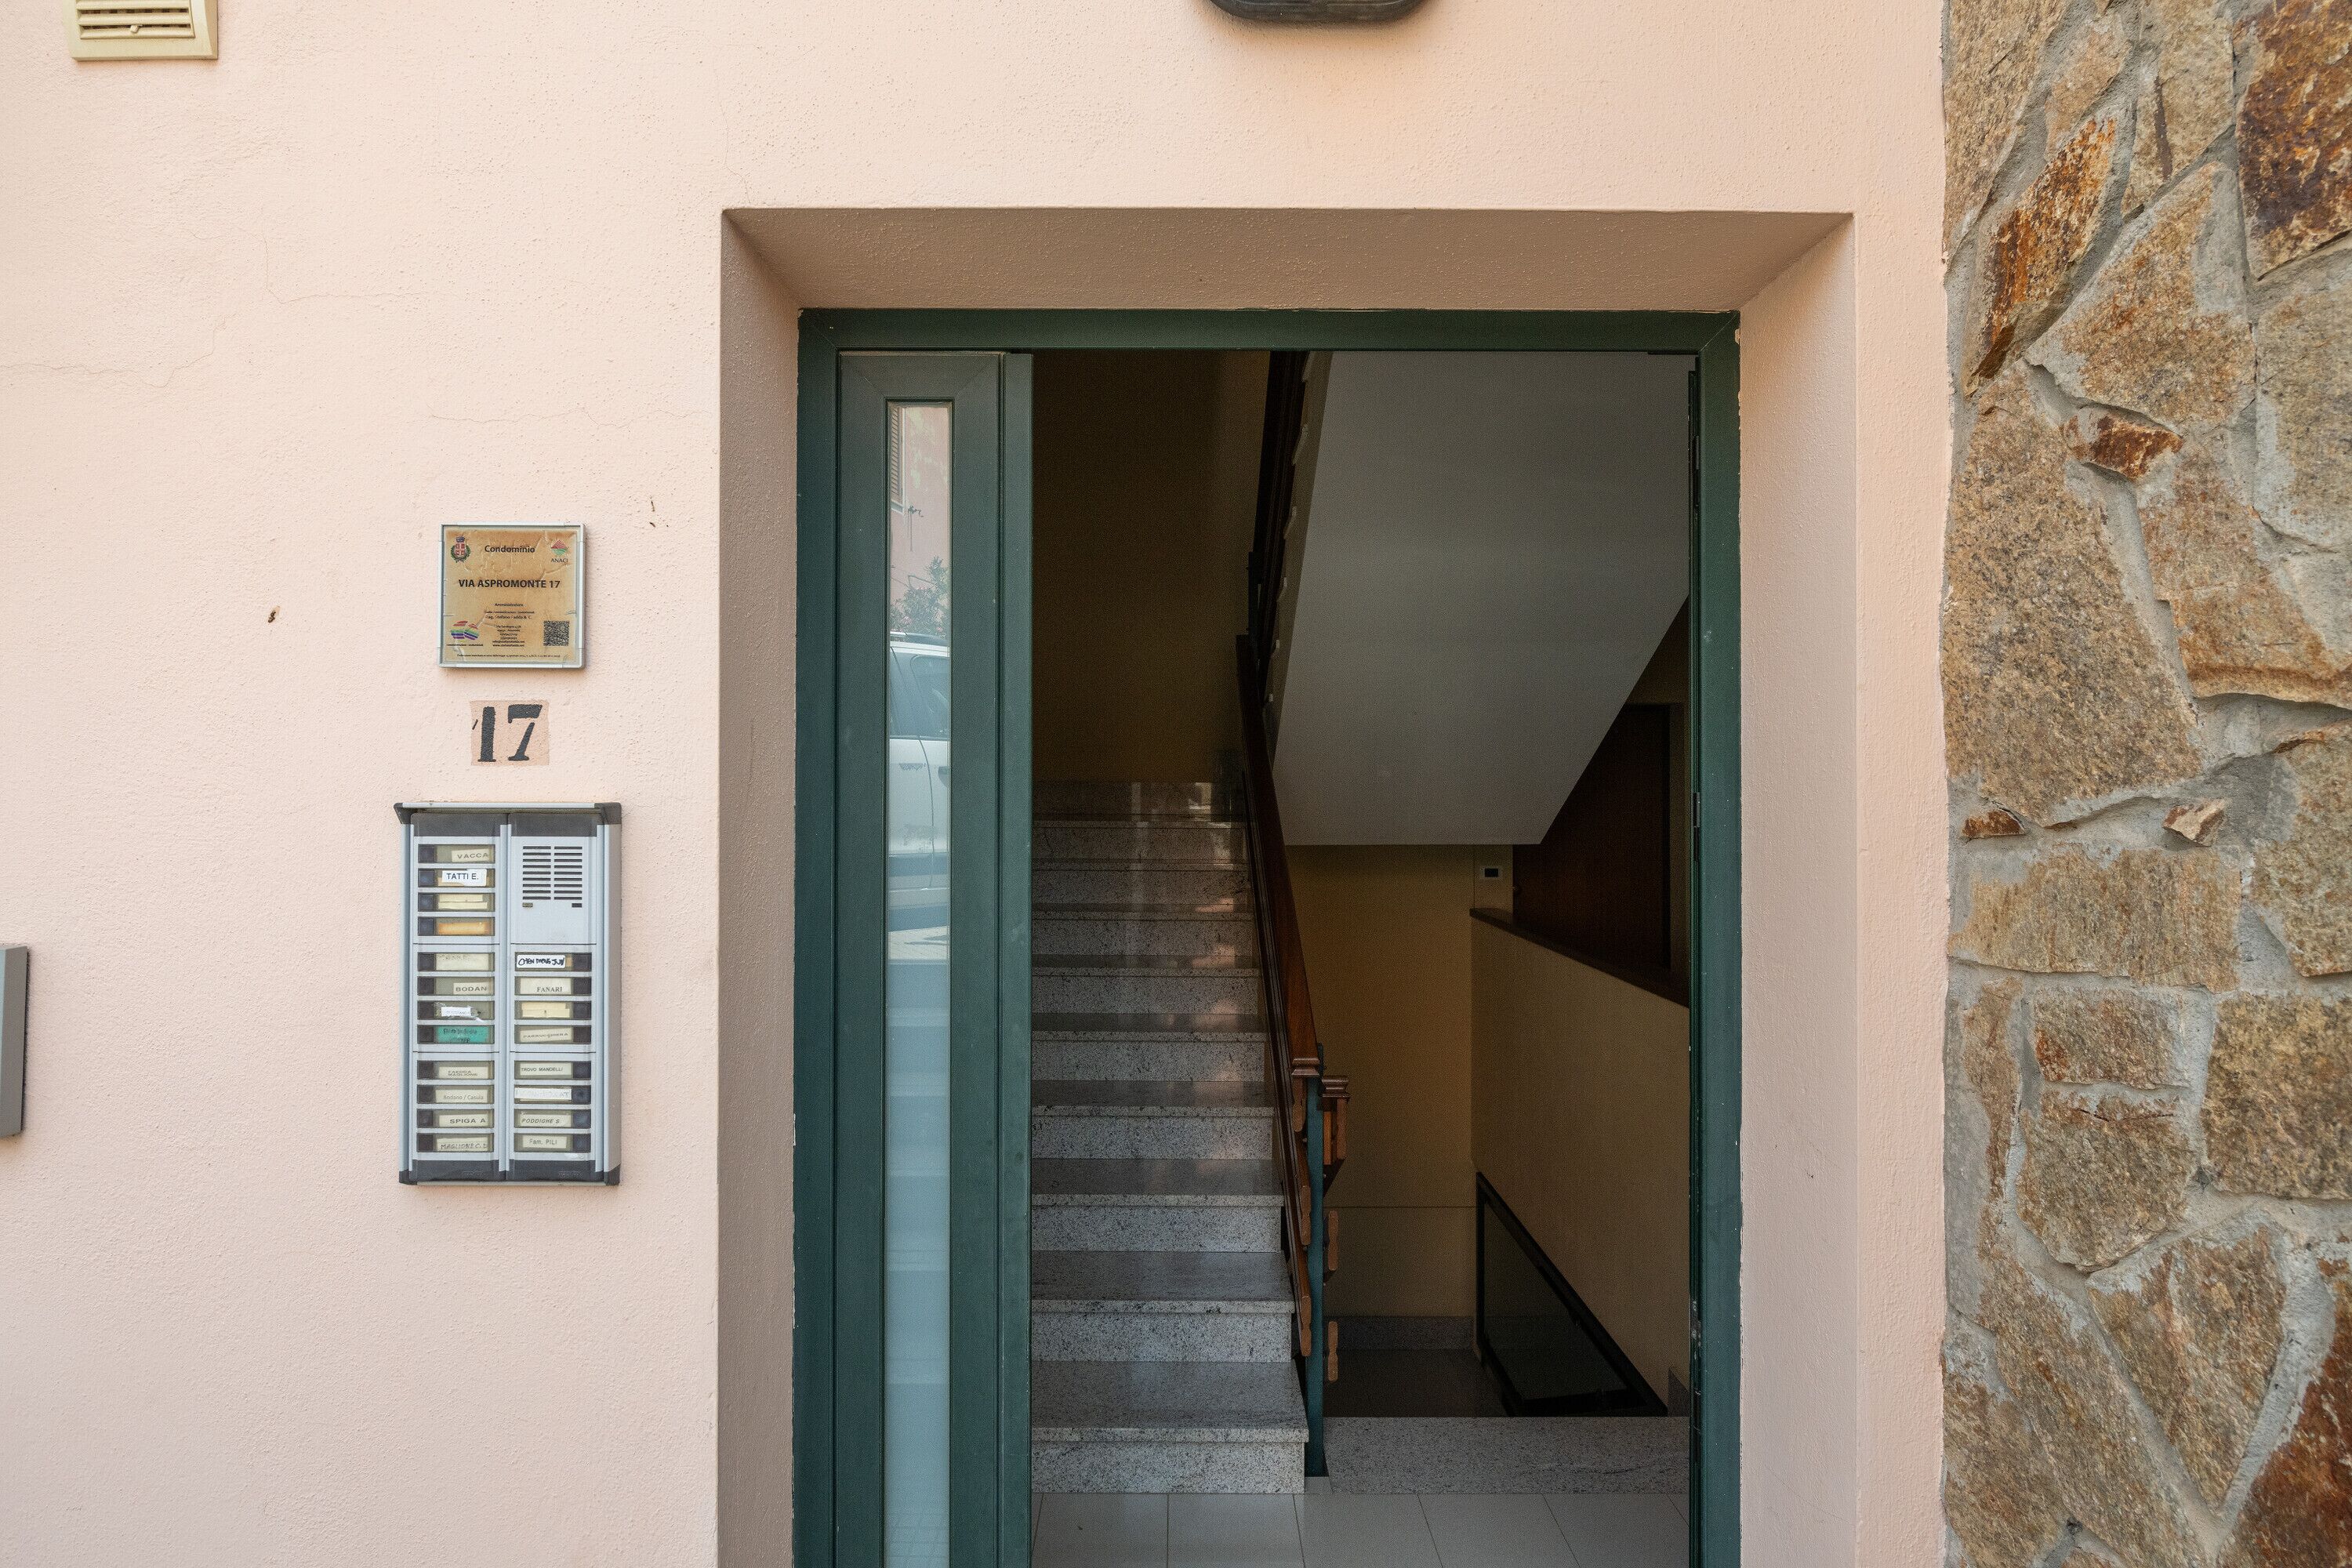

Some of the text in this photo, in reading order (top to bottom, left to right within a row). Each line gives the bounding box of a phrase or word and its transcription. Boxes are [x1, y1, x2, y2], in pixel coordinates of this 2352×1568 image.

[458, 579, 475, 587] VIA
[477, 579, 546, 588] ASPROMONTE
[477, 703, 543, 763] 17
